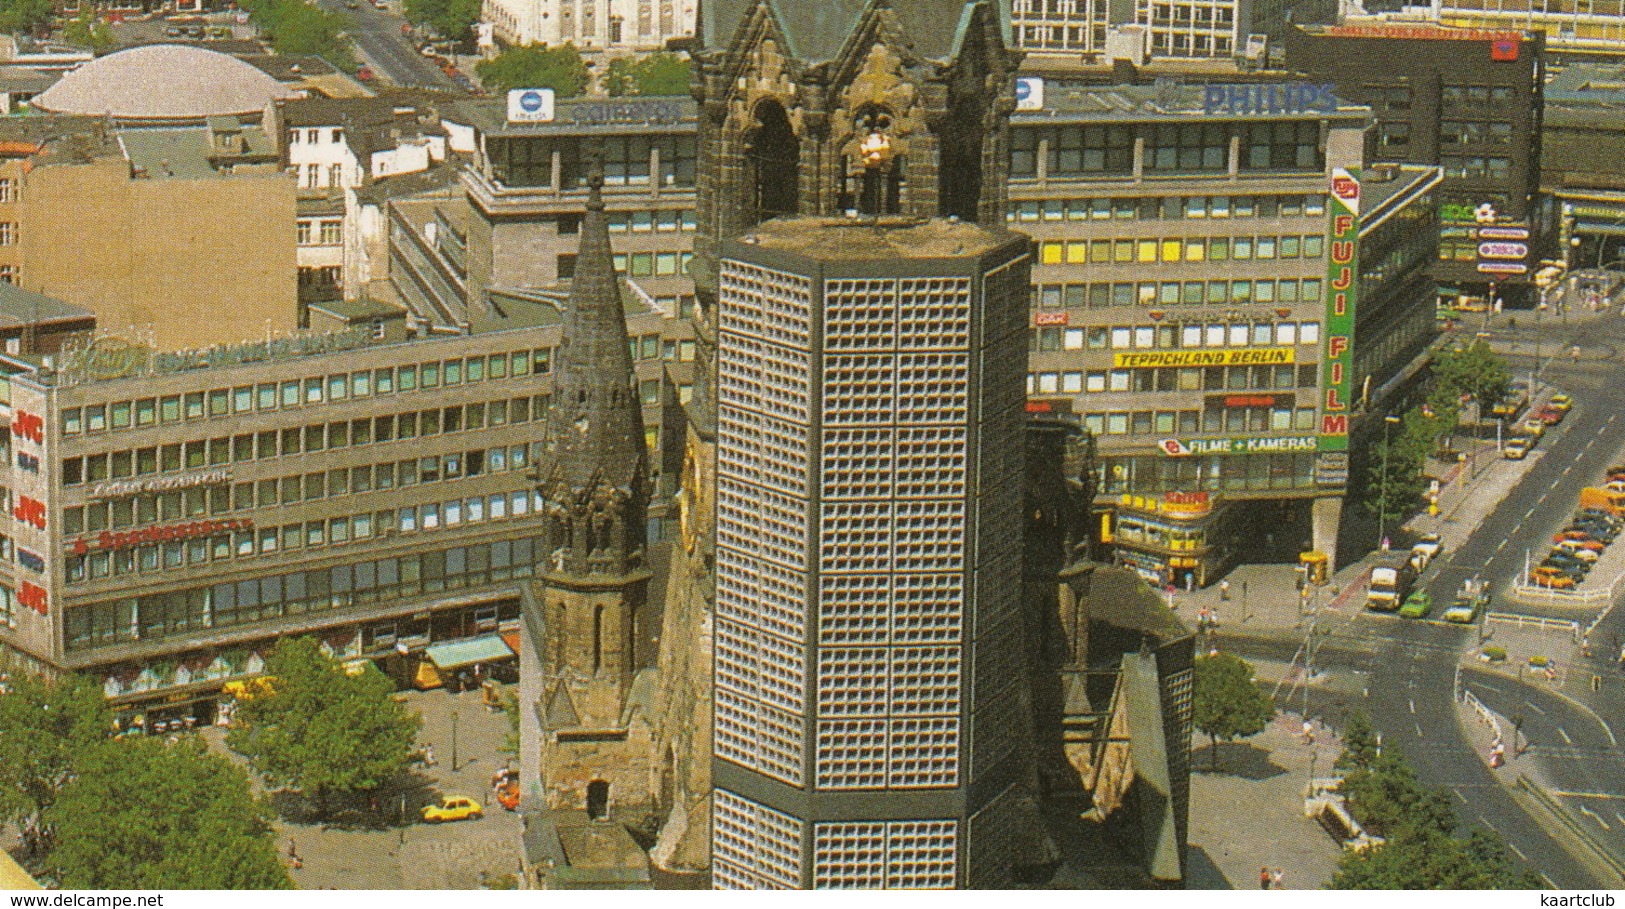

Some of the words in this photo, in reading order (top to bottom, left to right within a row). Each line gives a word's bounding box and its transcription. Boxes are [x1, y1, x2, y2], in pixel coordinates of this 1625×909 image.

[1205, 84, 1337, 115] PHILIPS
[1332, 215, 1354, 316] FUJI
[1119, 352, 1225, 368] TEPPICHLAND
[1230, 349, 1289, 364] BERLIN
[1322, 336, 1349, 436] FILM
[1189, 438, 1232, 452] FILME
[1235, 439, 1245, 450] +
[1247, 436, 1318, 451] KAMERAS
